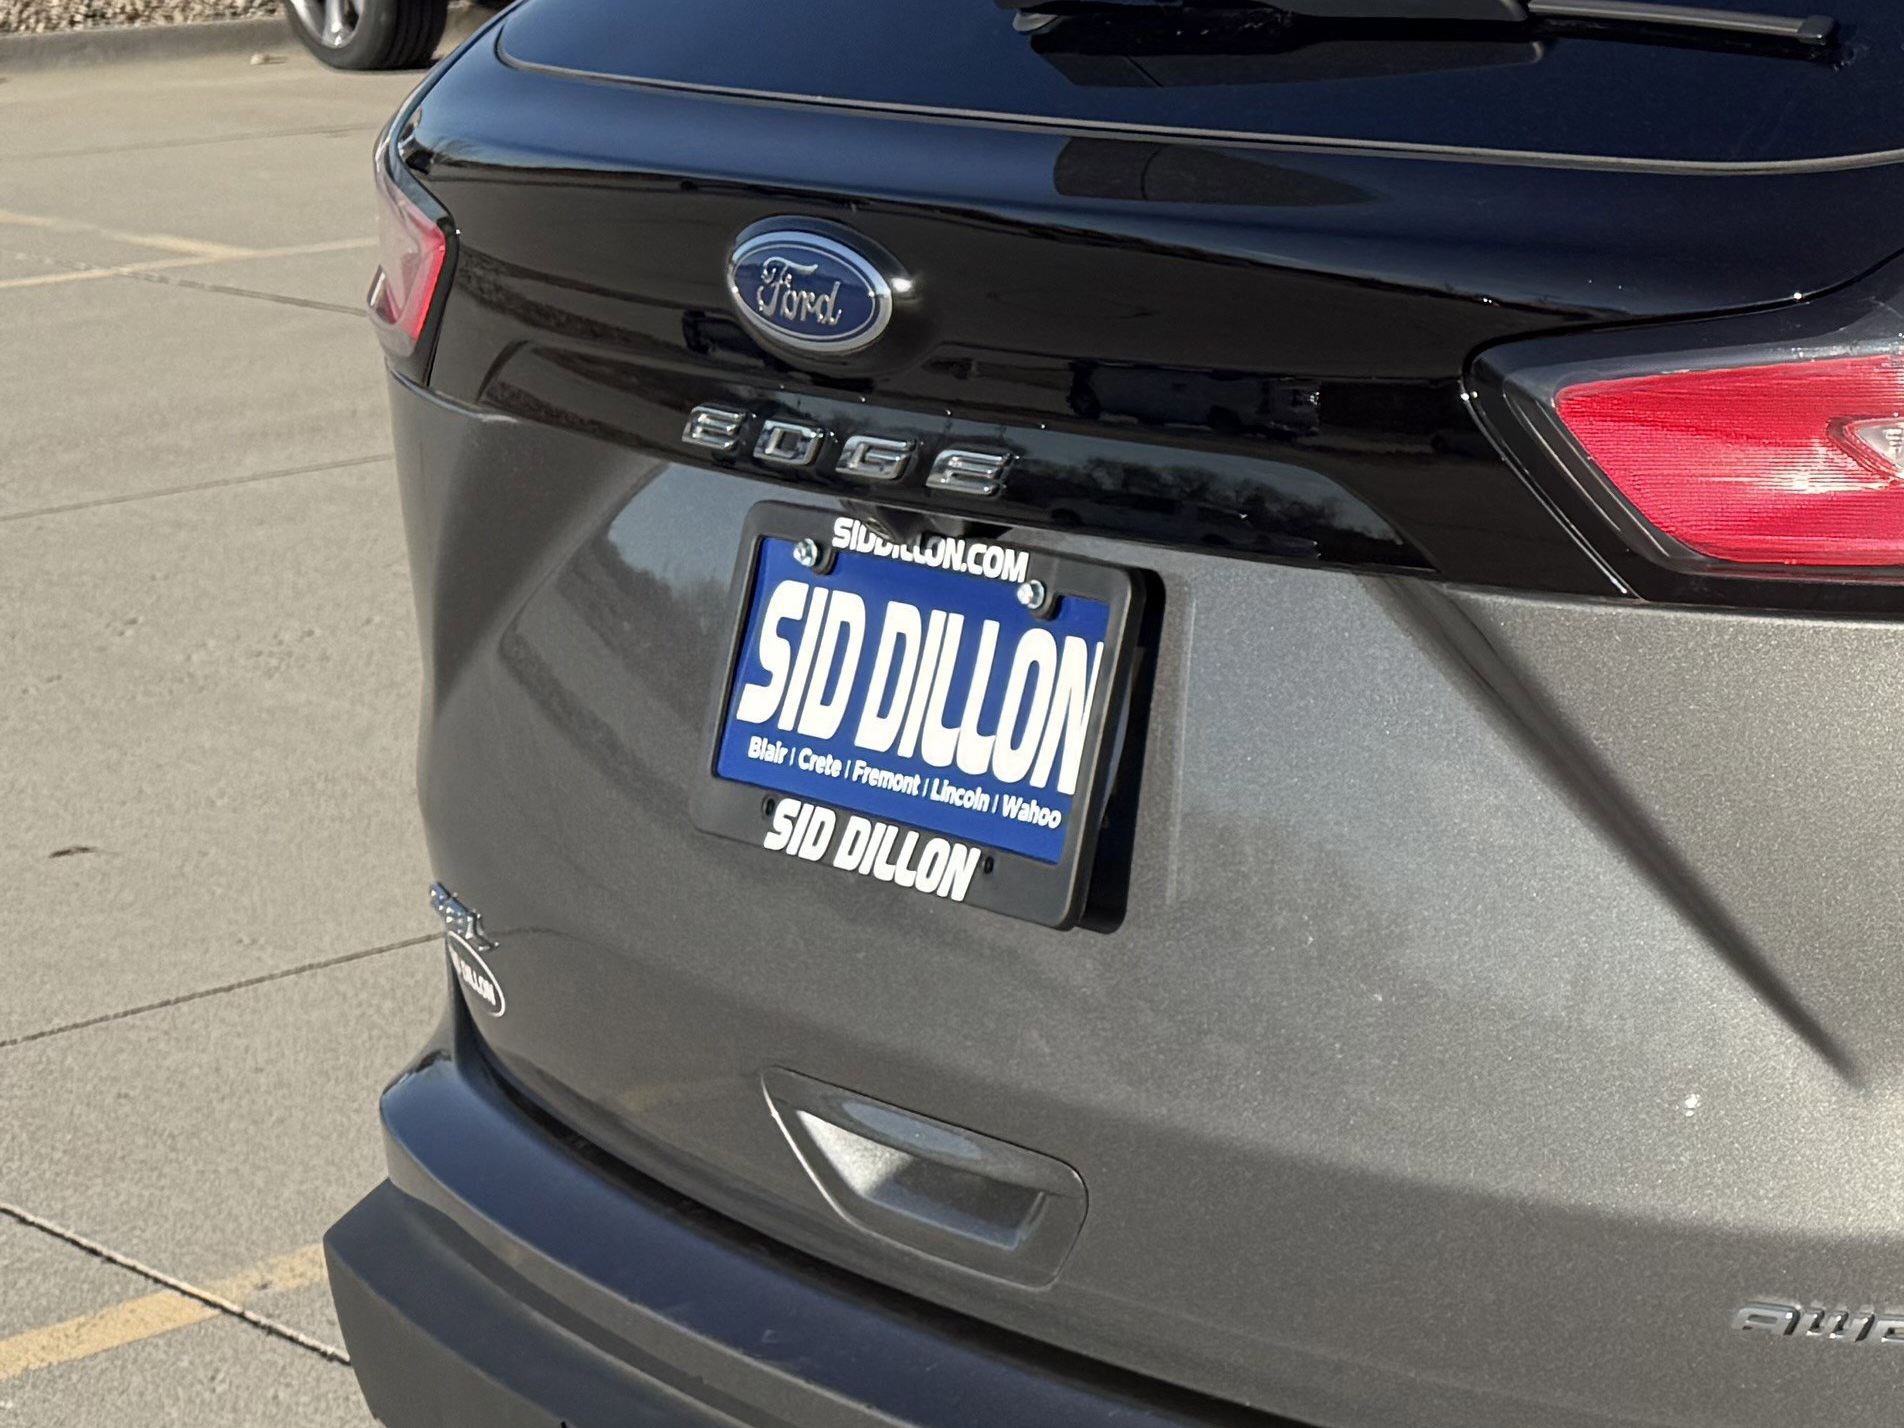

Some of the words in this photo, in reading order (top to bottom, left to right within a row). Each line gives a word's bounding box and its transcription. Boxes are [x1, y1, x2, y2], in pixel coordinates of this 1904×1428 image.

[756, 256, 843, 325] Ford
[681, 404, 1015, 497] EDGE
[736, 579, 866, 740] SID
[854, 600, 1105, 796] DILLON
[747, 735, 788, 765] Blair
[797, 747, 842, 778] Crete
[851, 760, 922, 798] Fremont
[929, 778, 990, 814] Lincoln
[1001, 793, 1063, 830] Wahoo
[763, 798, 836, 861] SID
[832, 815, 982, 902] DILLON
